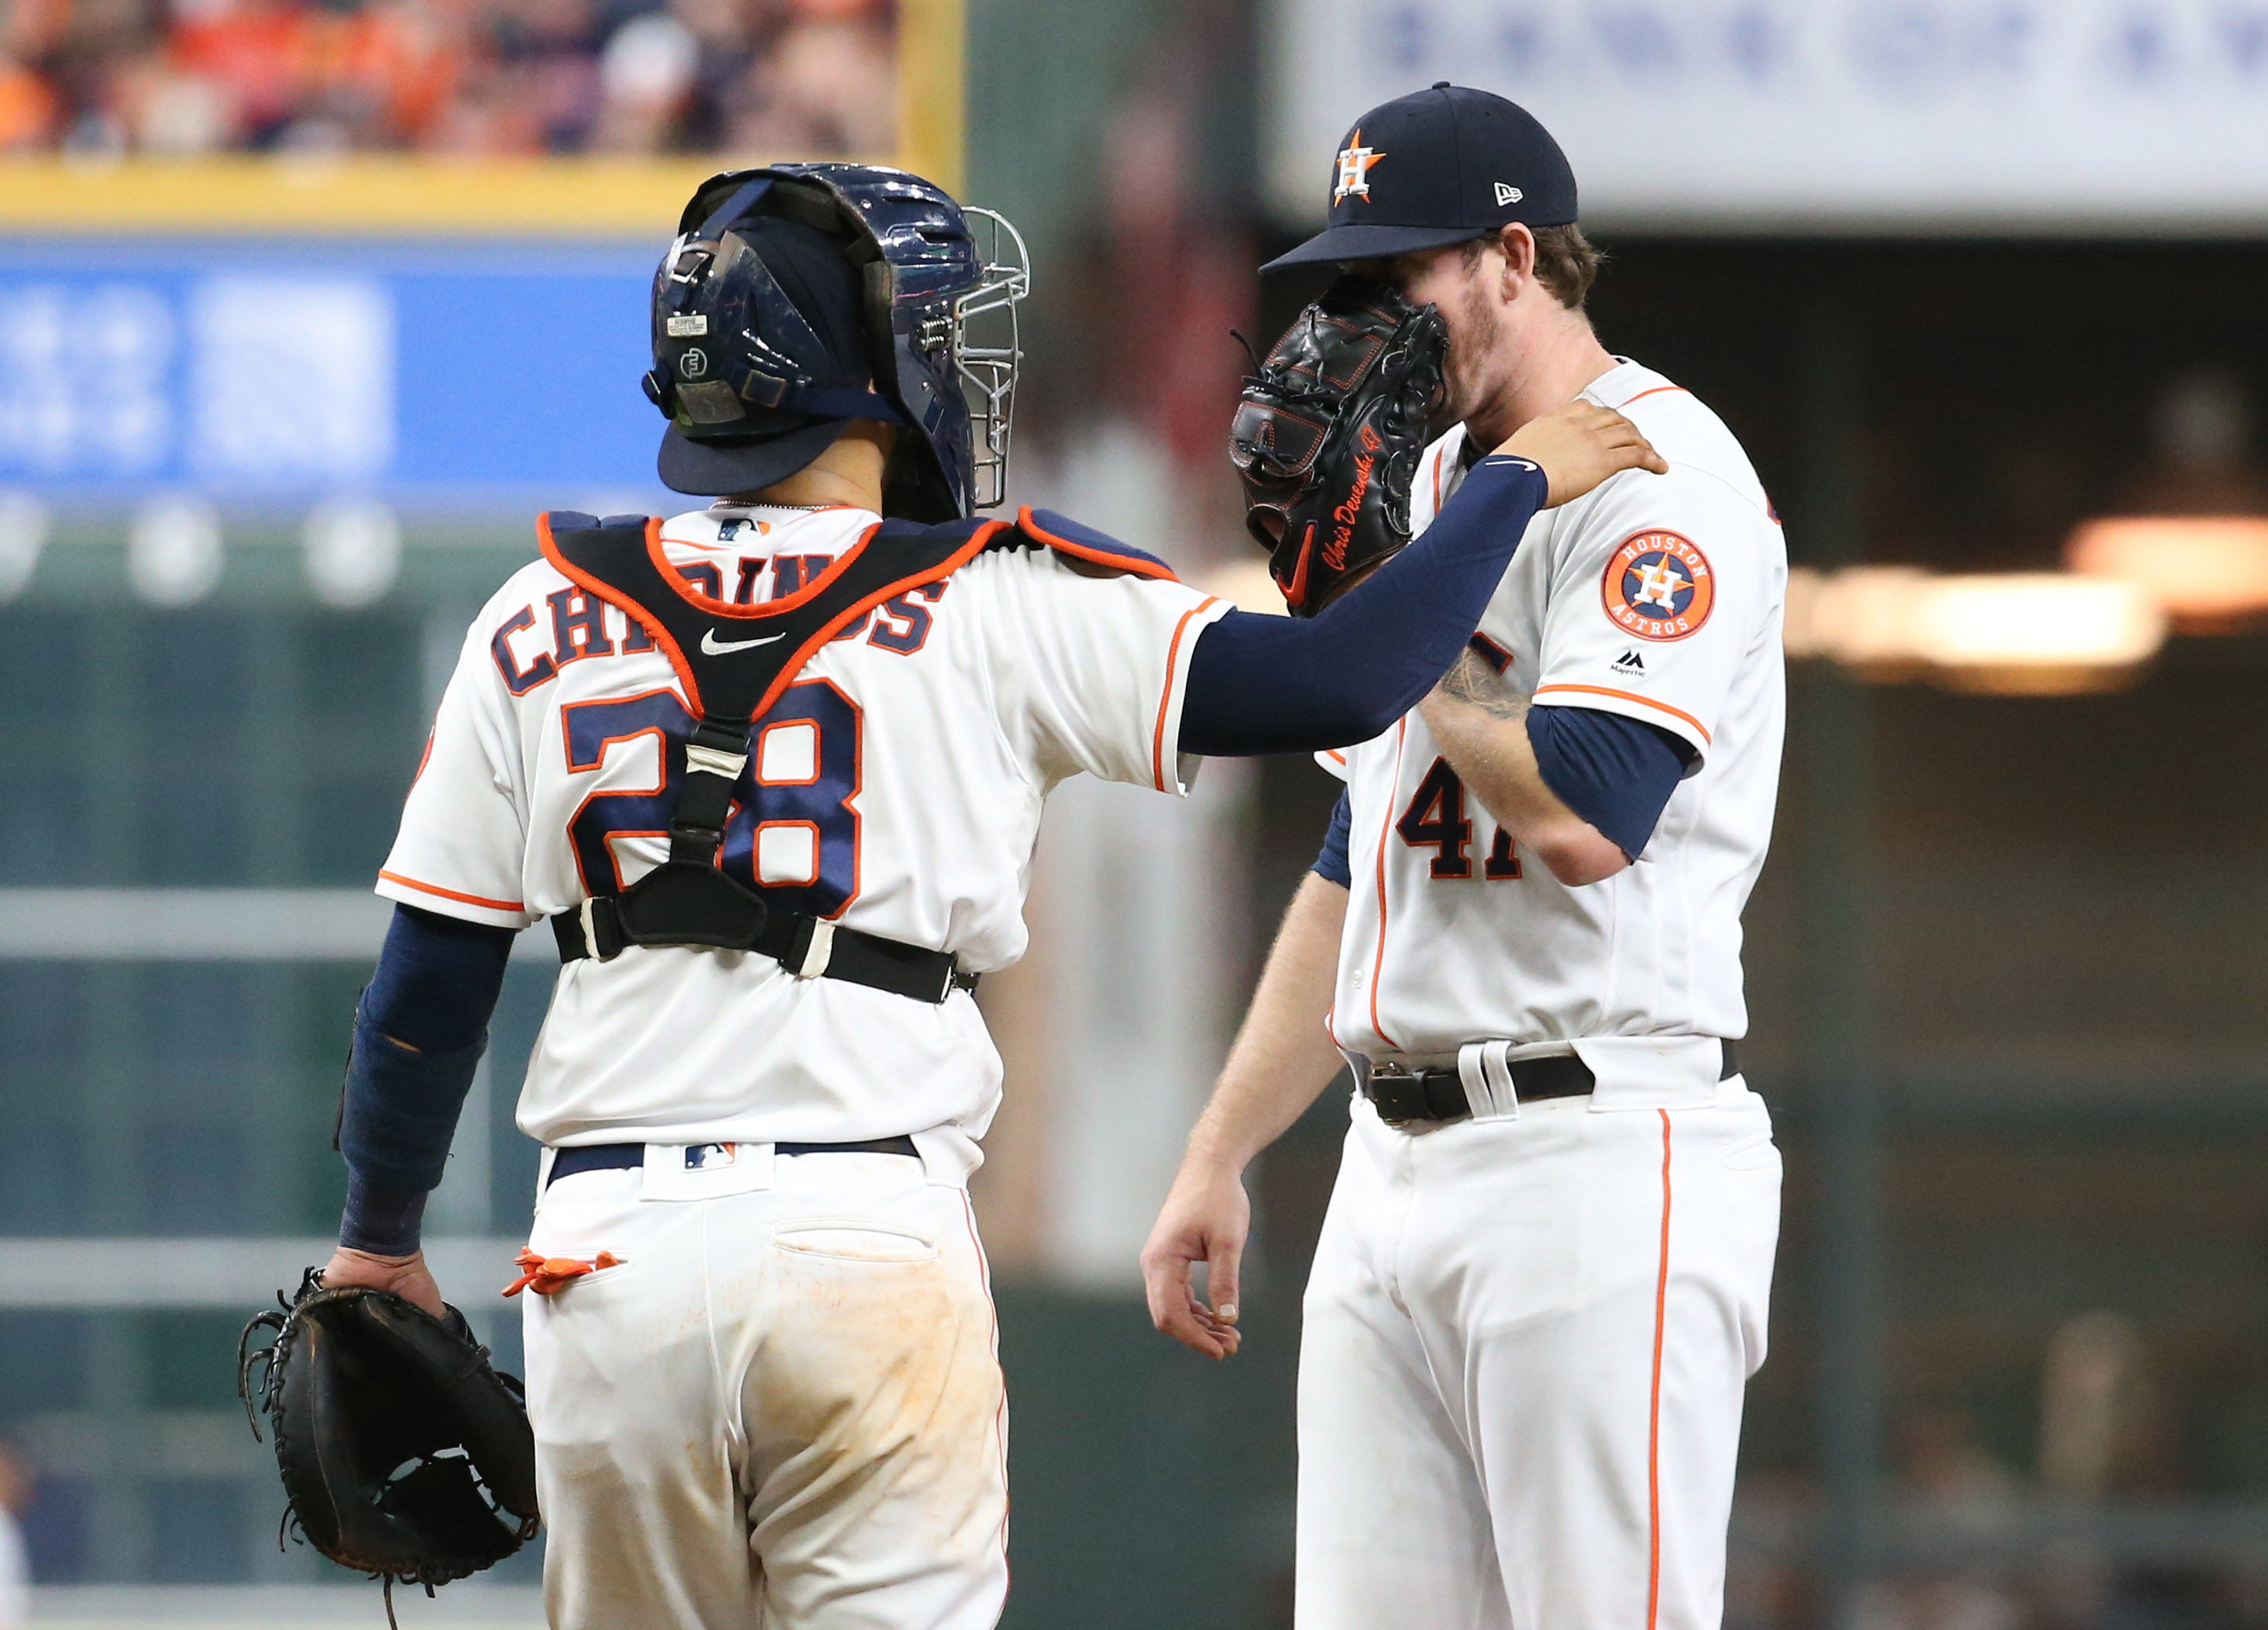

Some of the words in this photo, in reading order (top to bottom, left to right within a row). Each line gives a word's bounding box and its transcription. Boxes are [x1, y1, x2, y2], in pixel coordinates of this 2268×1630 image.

[1334, 146, 1374, 197] H
[1321, 526, 1352, 571] Chris
[1622, 535, 1708, 577] HOUSTON
[1634, 563, 1682, 610] H
[1612, 603, 1689, 635] ASTROS
[1610, 664, 1646, 677] Majestic
[561, 676, 863, 920] 28
